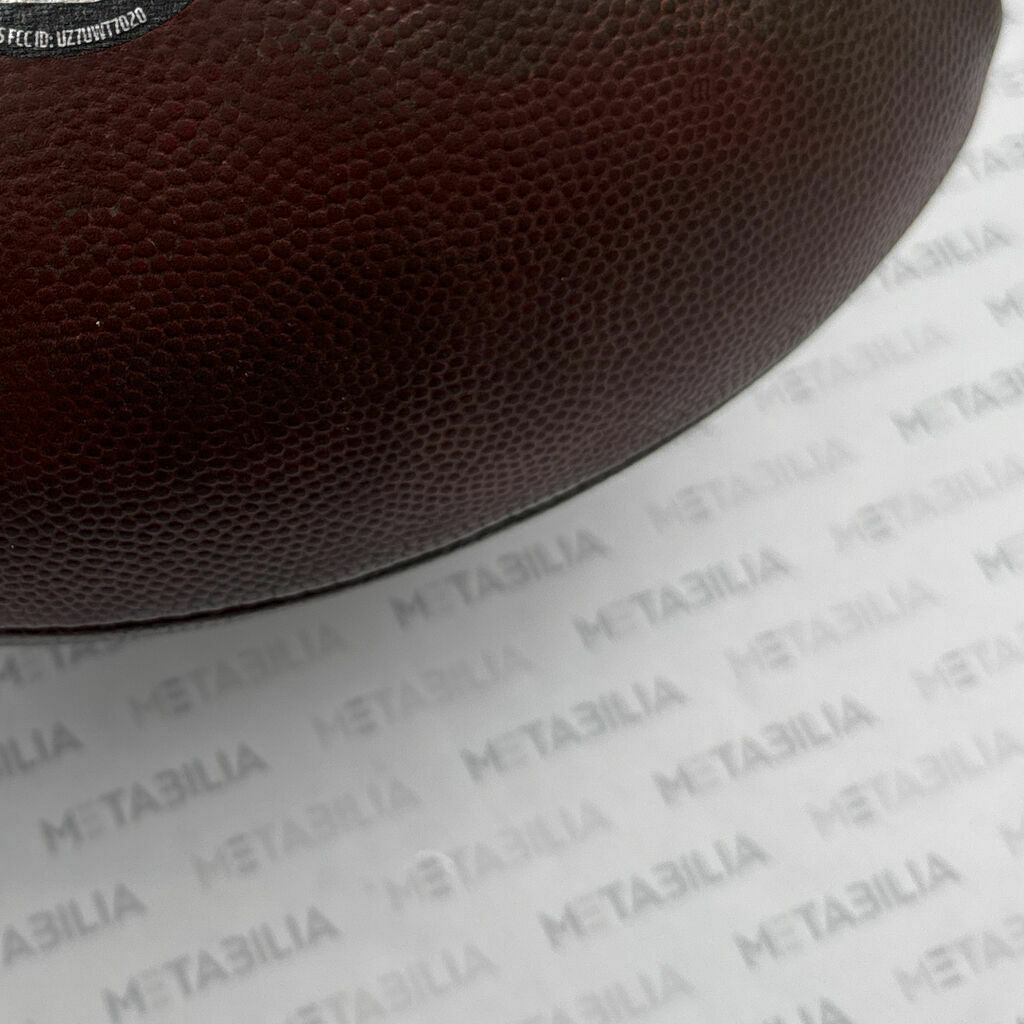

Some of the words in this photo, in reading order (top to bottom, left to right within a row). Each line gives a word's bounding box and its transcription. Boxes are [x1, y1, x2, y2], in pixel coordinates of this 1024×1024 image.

[7, 28, 34, 48] FCC
[34, 30, 54, 48] ID:
[56, 6, 148, 48] UZ7UWT7020
